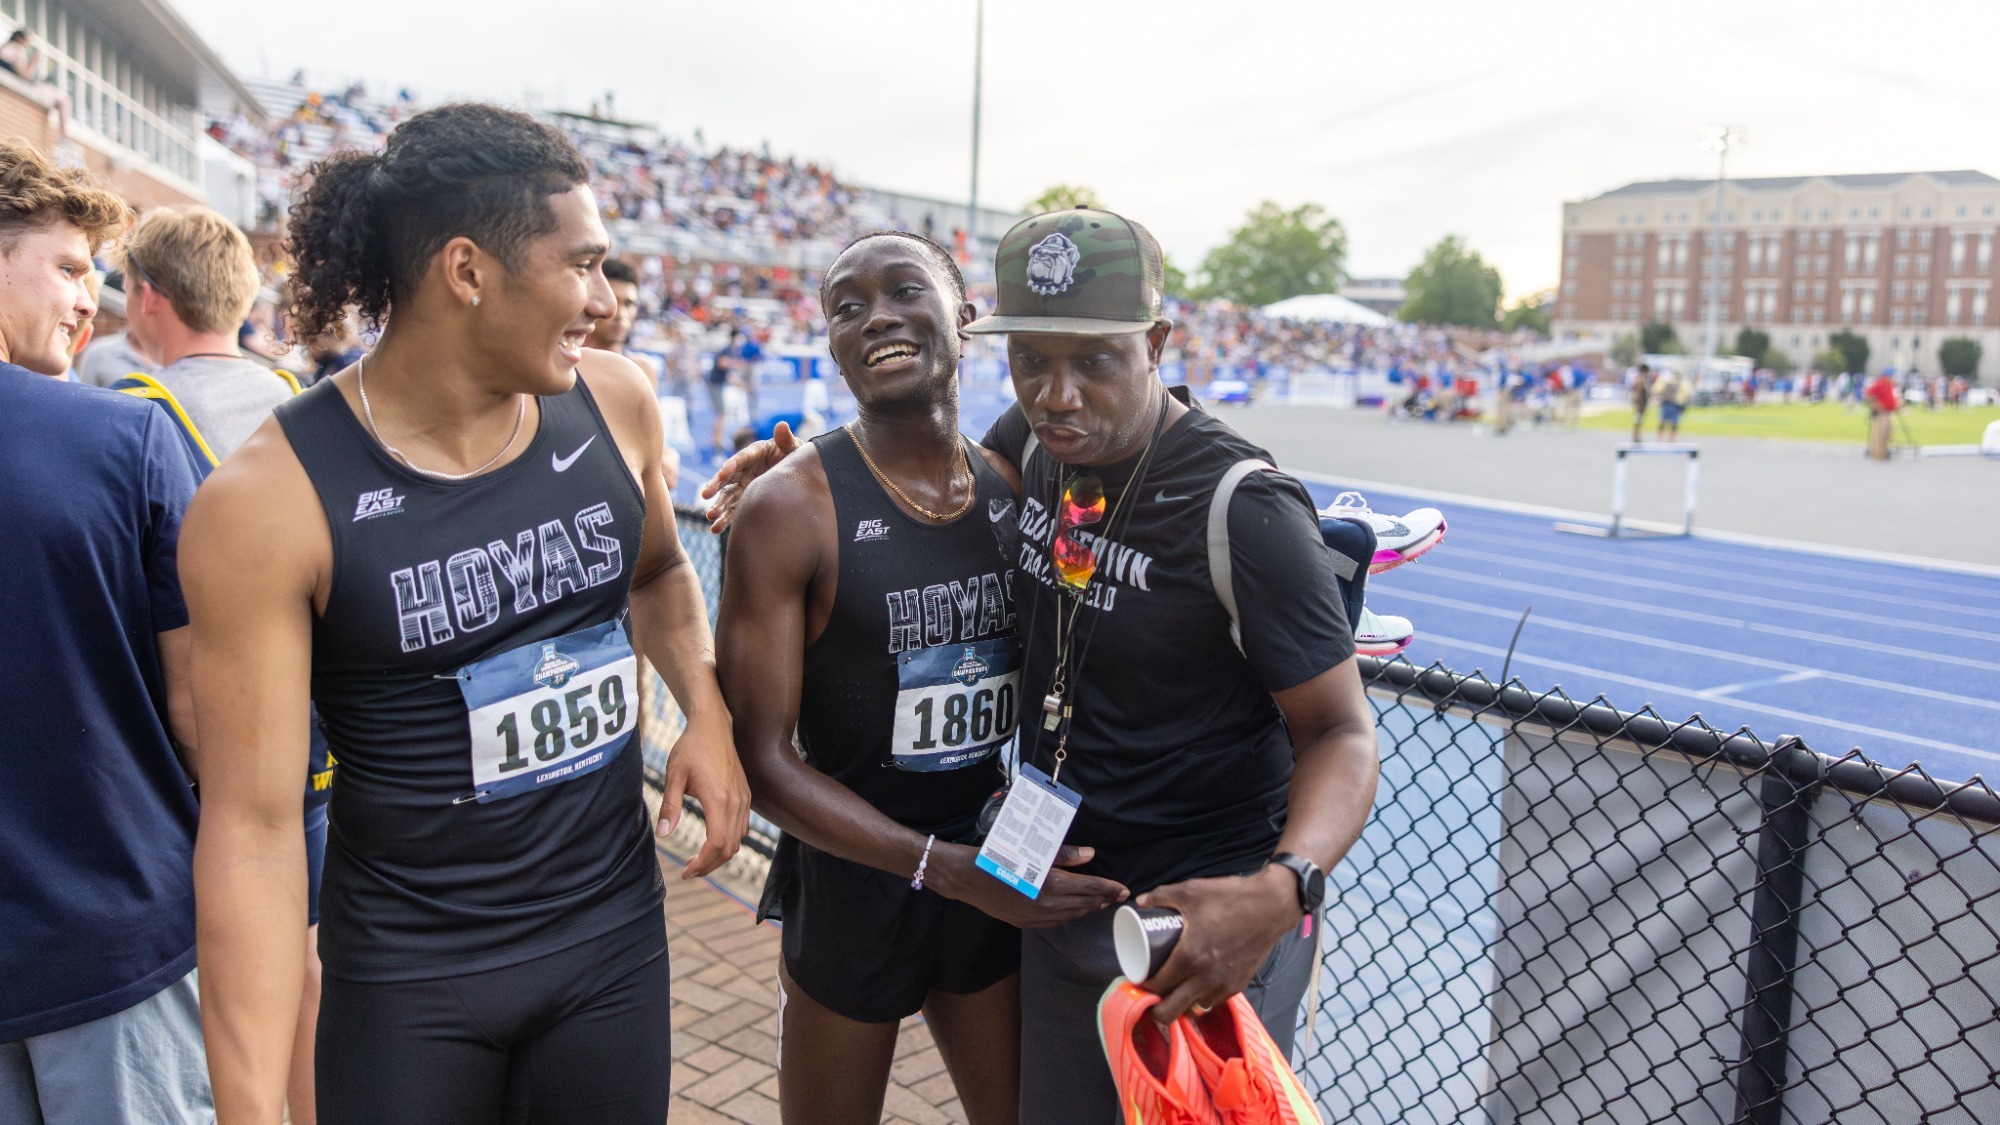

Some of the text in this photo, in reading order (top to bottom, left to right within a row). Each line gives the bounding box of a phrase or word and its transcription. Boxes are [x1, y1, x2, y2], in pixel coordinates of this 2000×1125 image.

[355, 495, 406, 516] EAST
[358, 487, 394, 505] BIG
[855, 526, 891, 537] EAST
[857, 518, 883, 529] BIG
[1018, 496, 1154, 592] GEOTOWN
[390, 501, 623, 653] HOYAS
[496, 674, 628, 774] 1859
[912, 682, 1014, 750] 1860
[536, 751, 604, 783] LEXINGTON, KENTUCKY
[996, 867, 1020, 886] COACH
